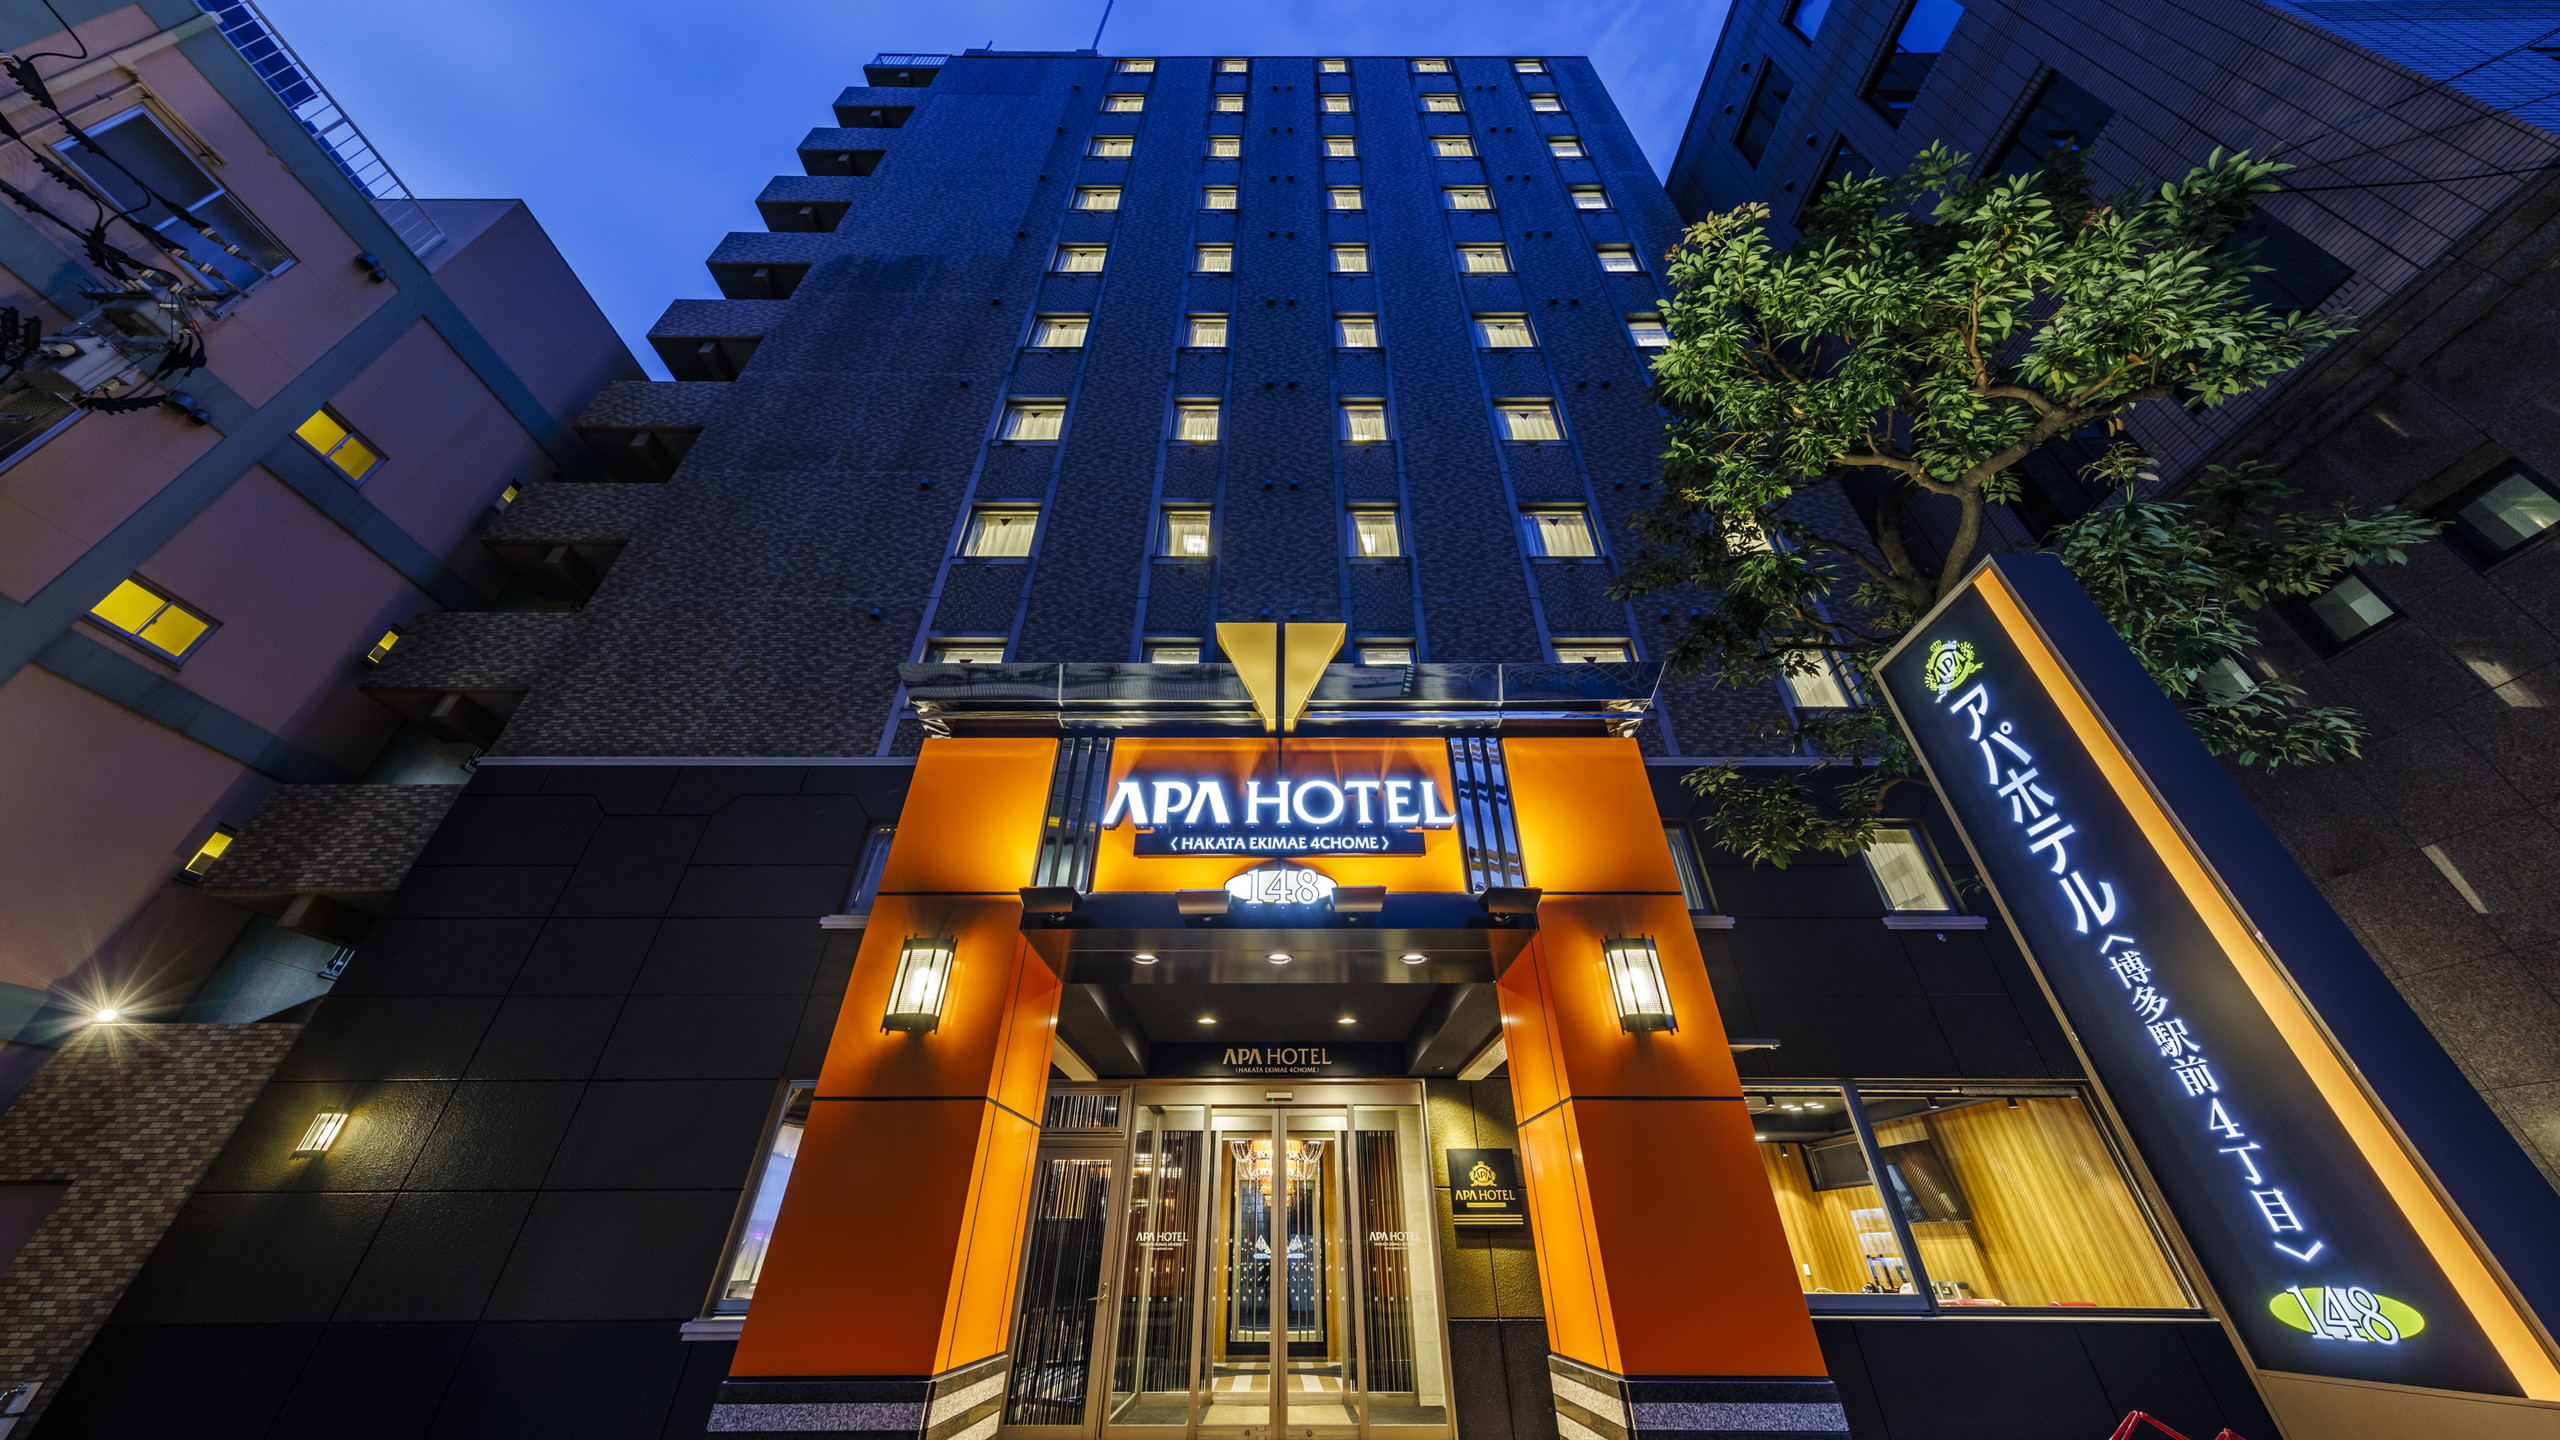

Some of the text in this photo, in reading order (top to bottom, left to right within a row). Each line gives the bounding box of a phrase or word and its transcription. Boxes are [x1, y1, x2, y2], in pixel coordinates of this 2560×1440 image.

[1102, 780, 1457, 824] APA HOTEL
[1249, 837, 1308, 849] EKIMAE
[1246, 868, 1320, 904] 148
[1222, 1048, 1332, 1065] APA HOTEL
[1455, 1189, 1516, 1201] APA HOTEL
[1135, 1231, 1188, 1242] APA HOTEL
[1369, 1231, 1421, 1242] APA HOTEL
[2286, 1284, 2401, 1345] 148
